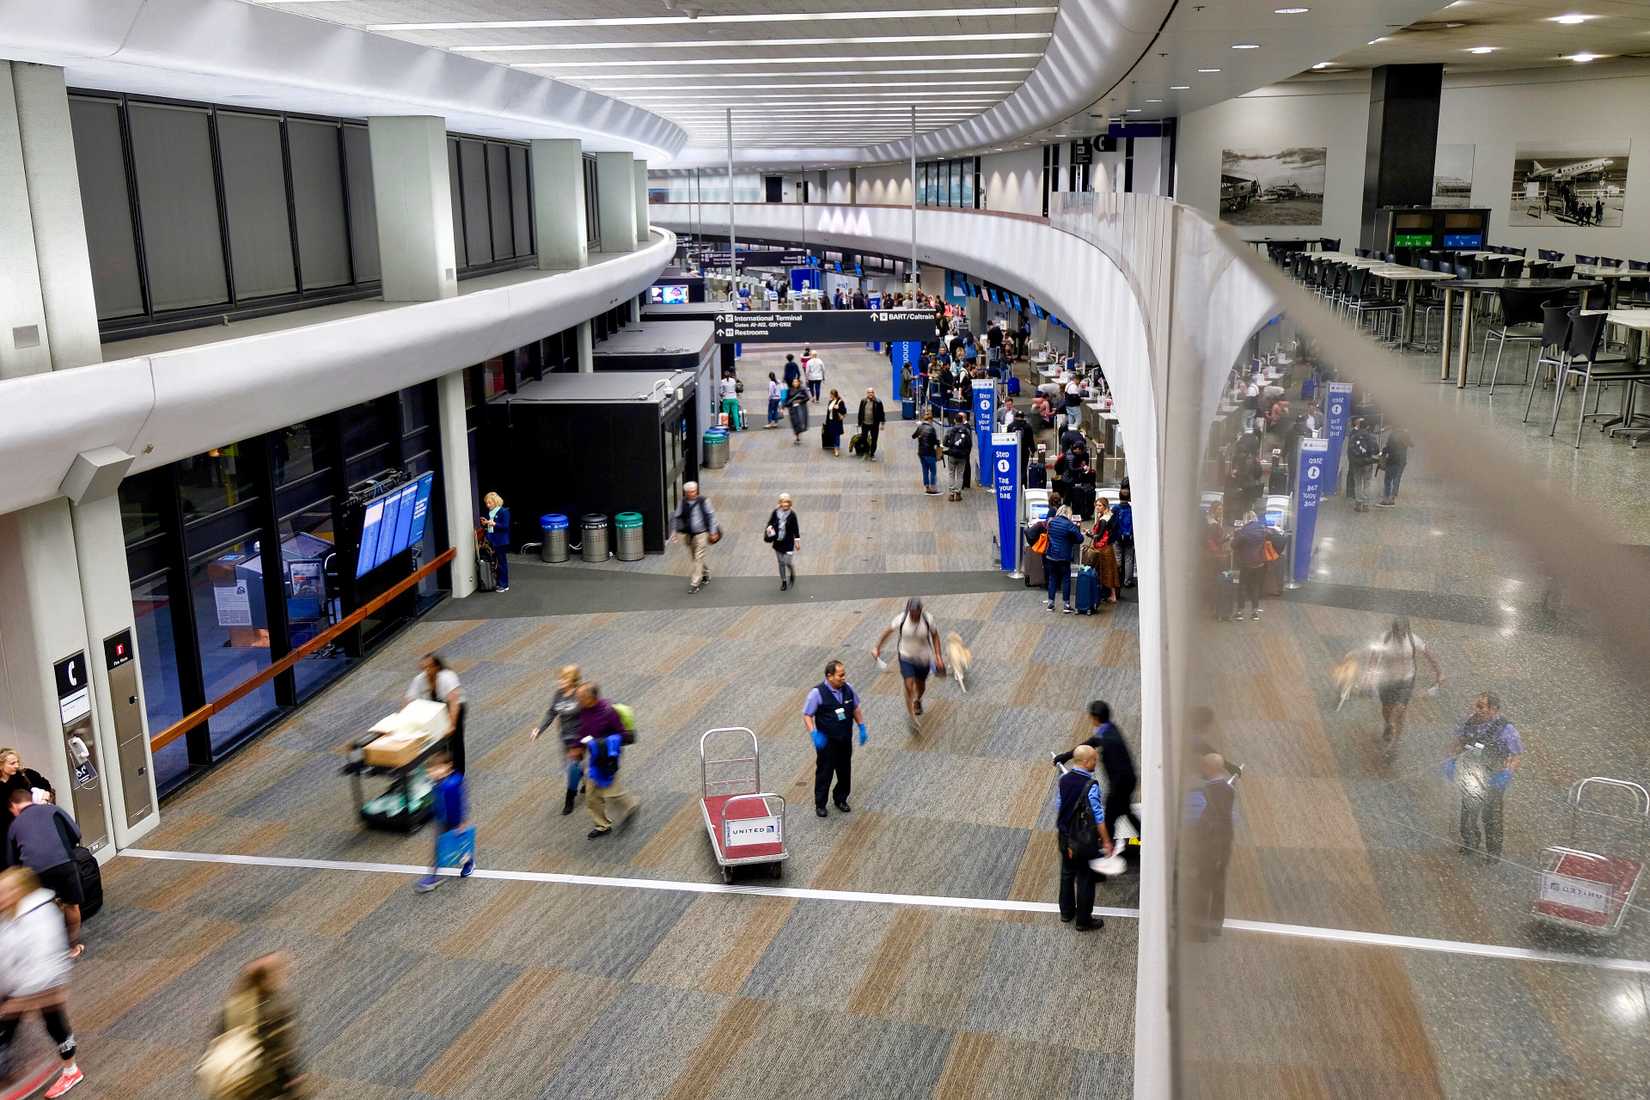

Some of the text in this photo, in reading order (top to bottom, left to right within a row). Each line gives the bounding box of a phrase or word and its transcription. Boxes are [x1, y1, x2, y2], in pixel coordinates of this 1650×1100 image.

[734, 314, 774, 322] International
[995, 450, 1010, 458] Step
[998, 477, 1009, 485] Tag
[998, 484, 1013, 492] your
